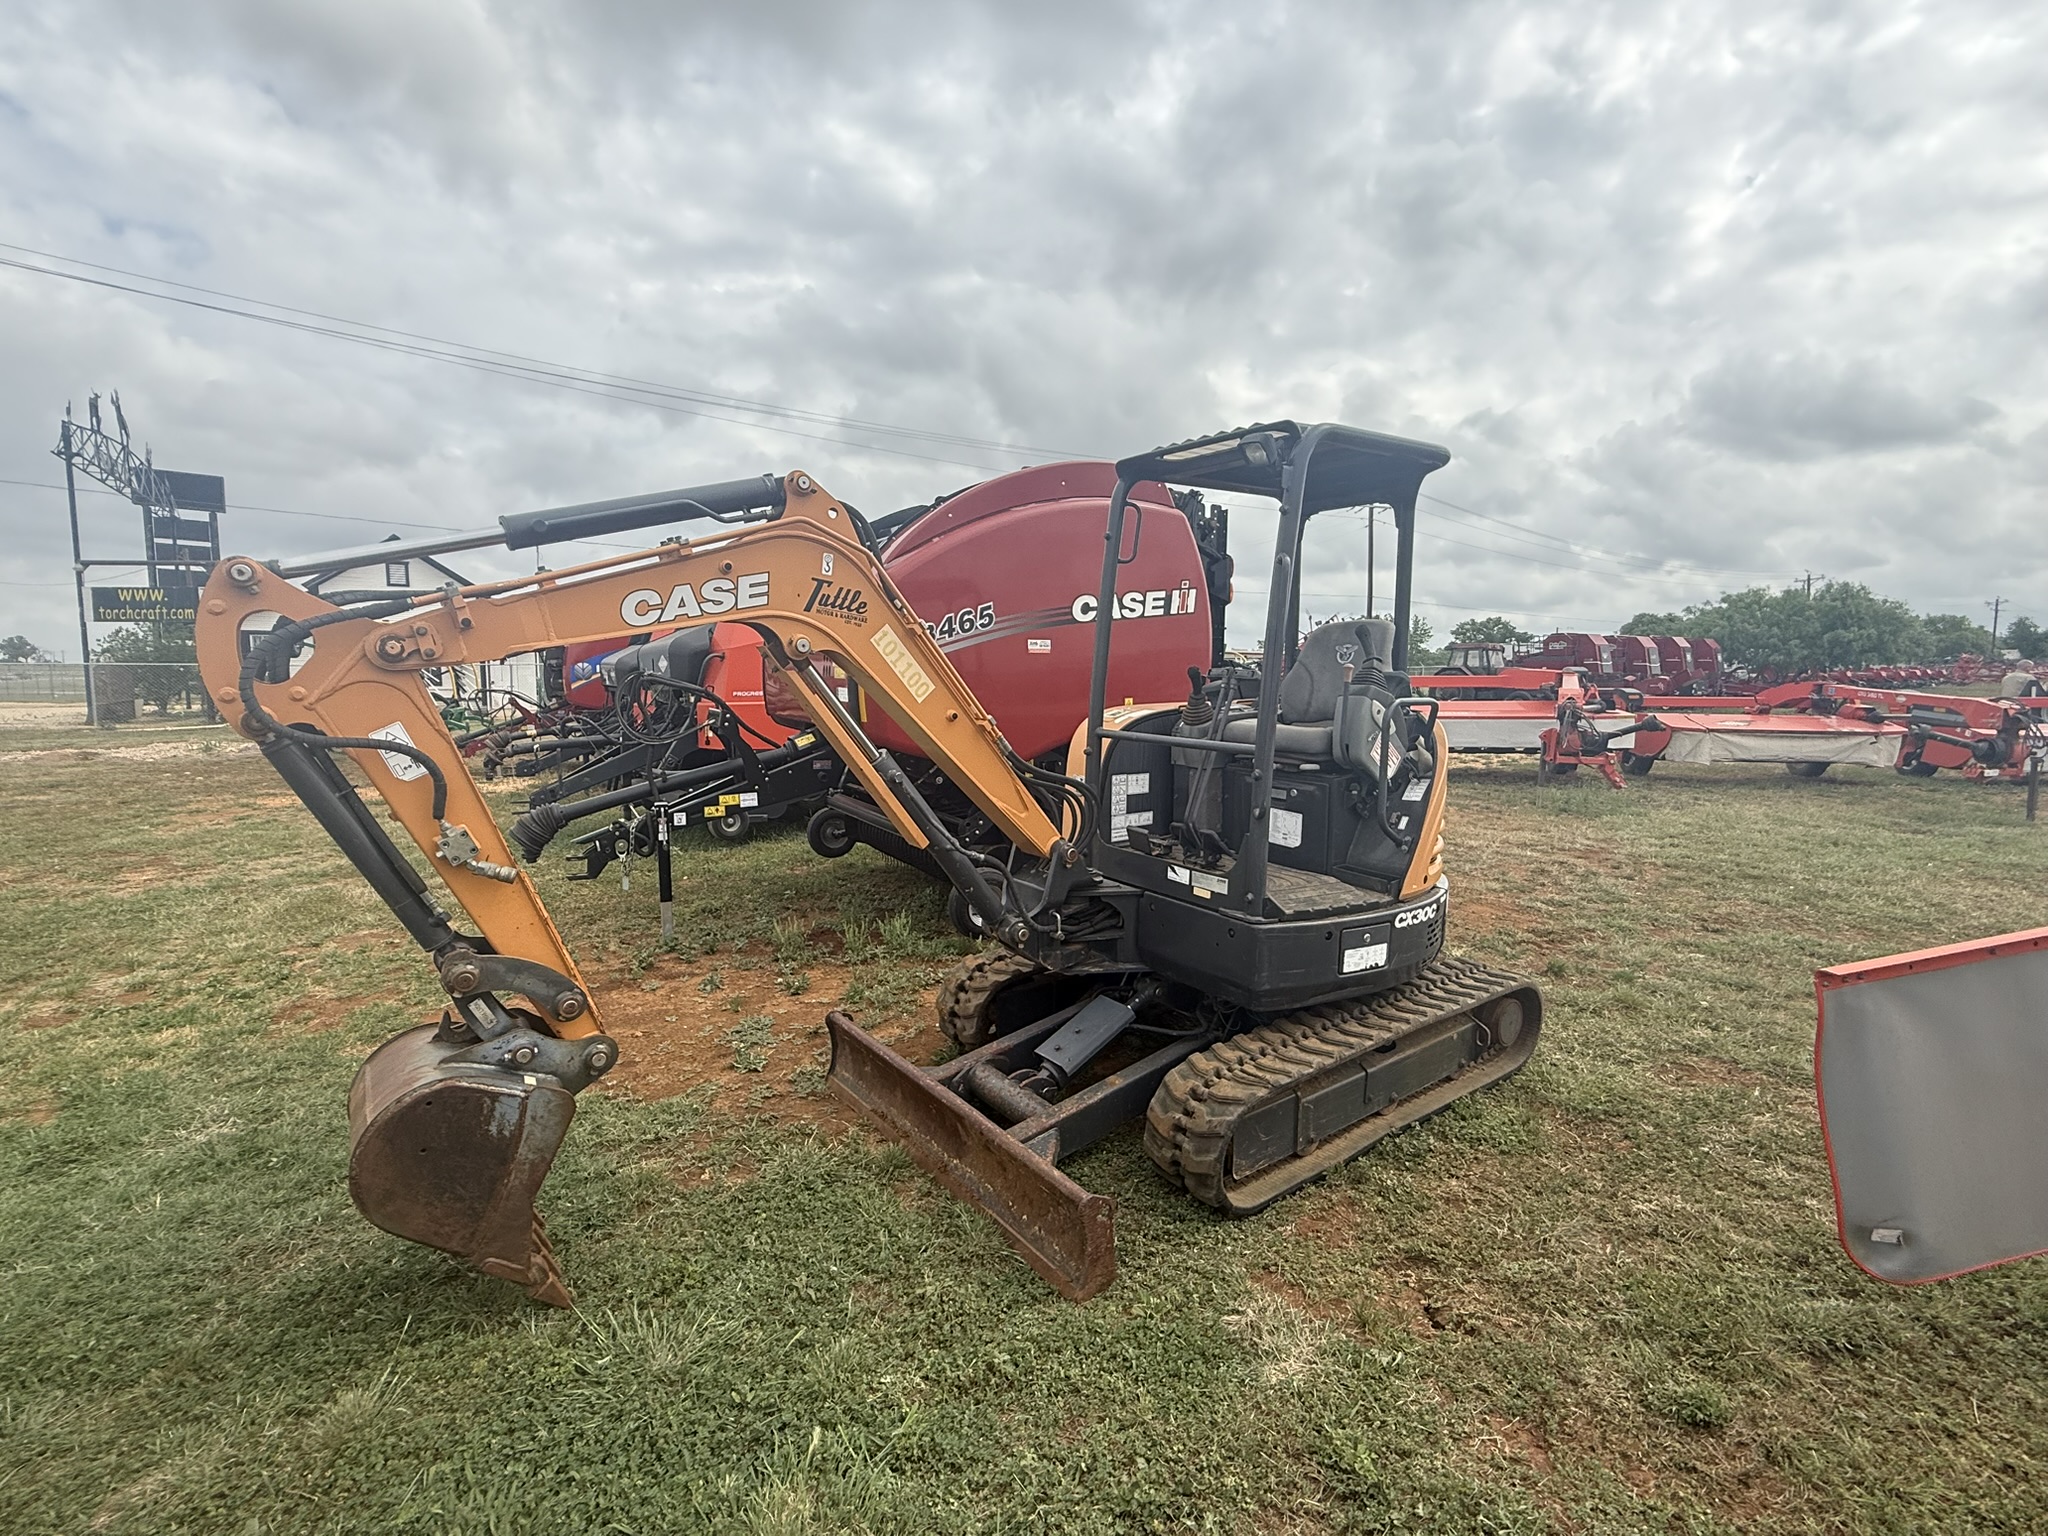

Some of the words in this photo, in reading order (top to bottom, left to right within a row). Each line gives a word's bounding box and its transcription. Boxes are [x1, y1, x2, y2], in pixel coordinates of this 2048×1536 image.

[620, 571, 770, 627] CASE
[803, 577, 868, 614] Tuttle
[98, 604, 196, 620] torchcraft.com
[816, 608, 834, 616] MOTOR
[839, 612, 868, 623] HARDWARE
[873, 629, 930, 698] 101100
[1394, 903, 1437, 928] CX30C
